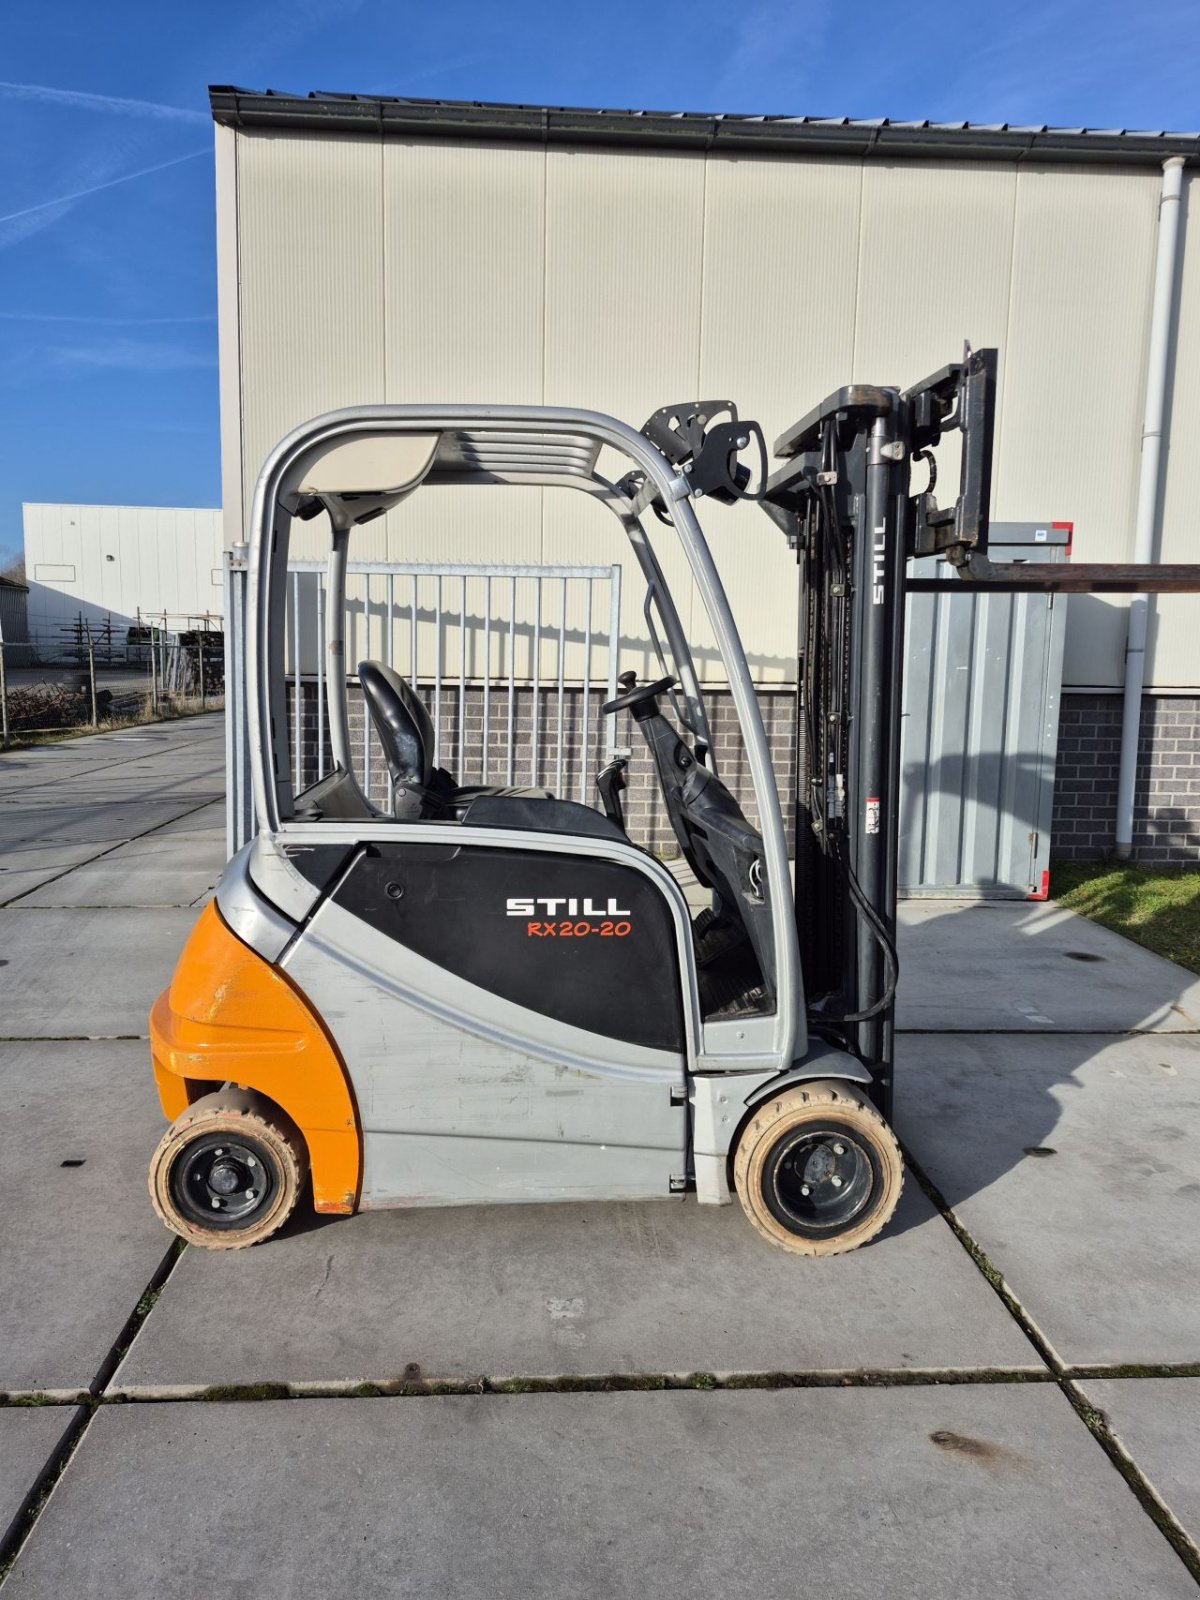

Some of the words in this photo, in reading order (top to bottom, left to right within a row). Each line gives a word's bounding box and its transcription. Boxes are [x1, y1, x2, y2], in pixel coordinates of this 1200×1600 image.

[873, 517, 886, 605] STILL
[506, 898, 631, 916] STILL
[527, 921, 632, 937] RX20-20
